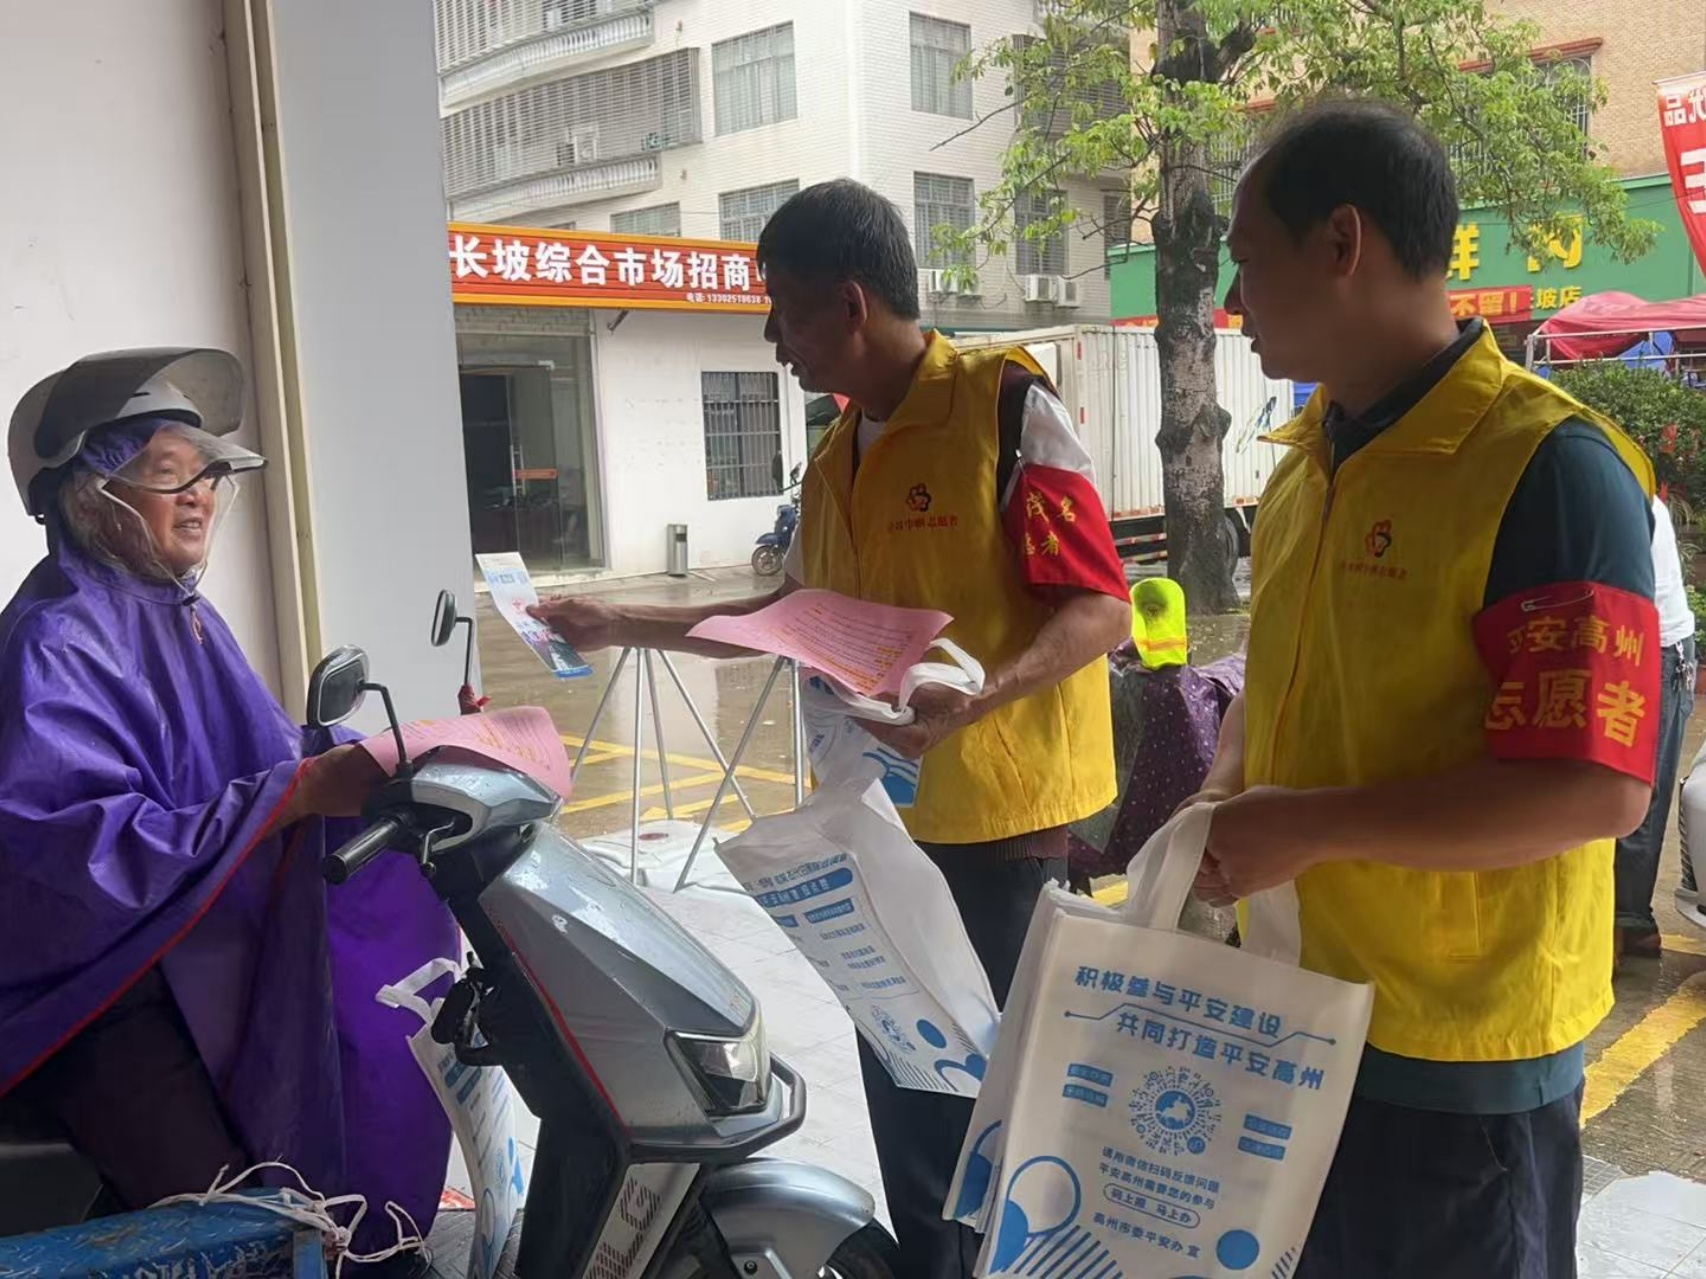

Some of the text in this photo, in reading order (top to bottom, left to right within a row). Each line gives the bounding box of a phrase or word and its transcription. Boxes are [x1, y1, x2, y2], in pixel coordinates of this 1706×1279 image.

[449, 235, 766, 291] 长坡综合市场招商
[1074, 966, 1282, 1038] 积极参与平安建设
[1117, 1011, 1324, 1089] 共同打造平安高州
[1099, 1162, 1215, 1209] 平安高州需要您的参与
[1102, 1147, 1220, 1193] 请用微信扫码反馈问题
